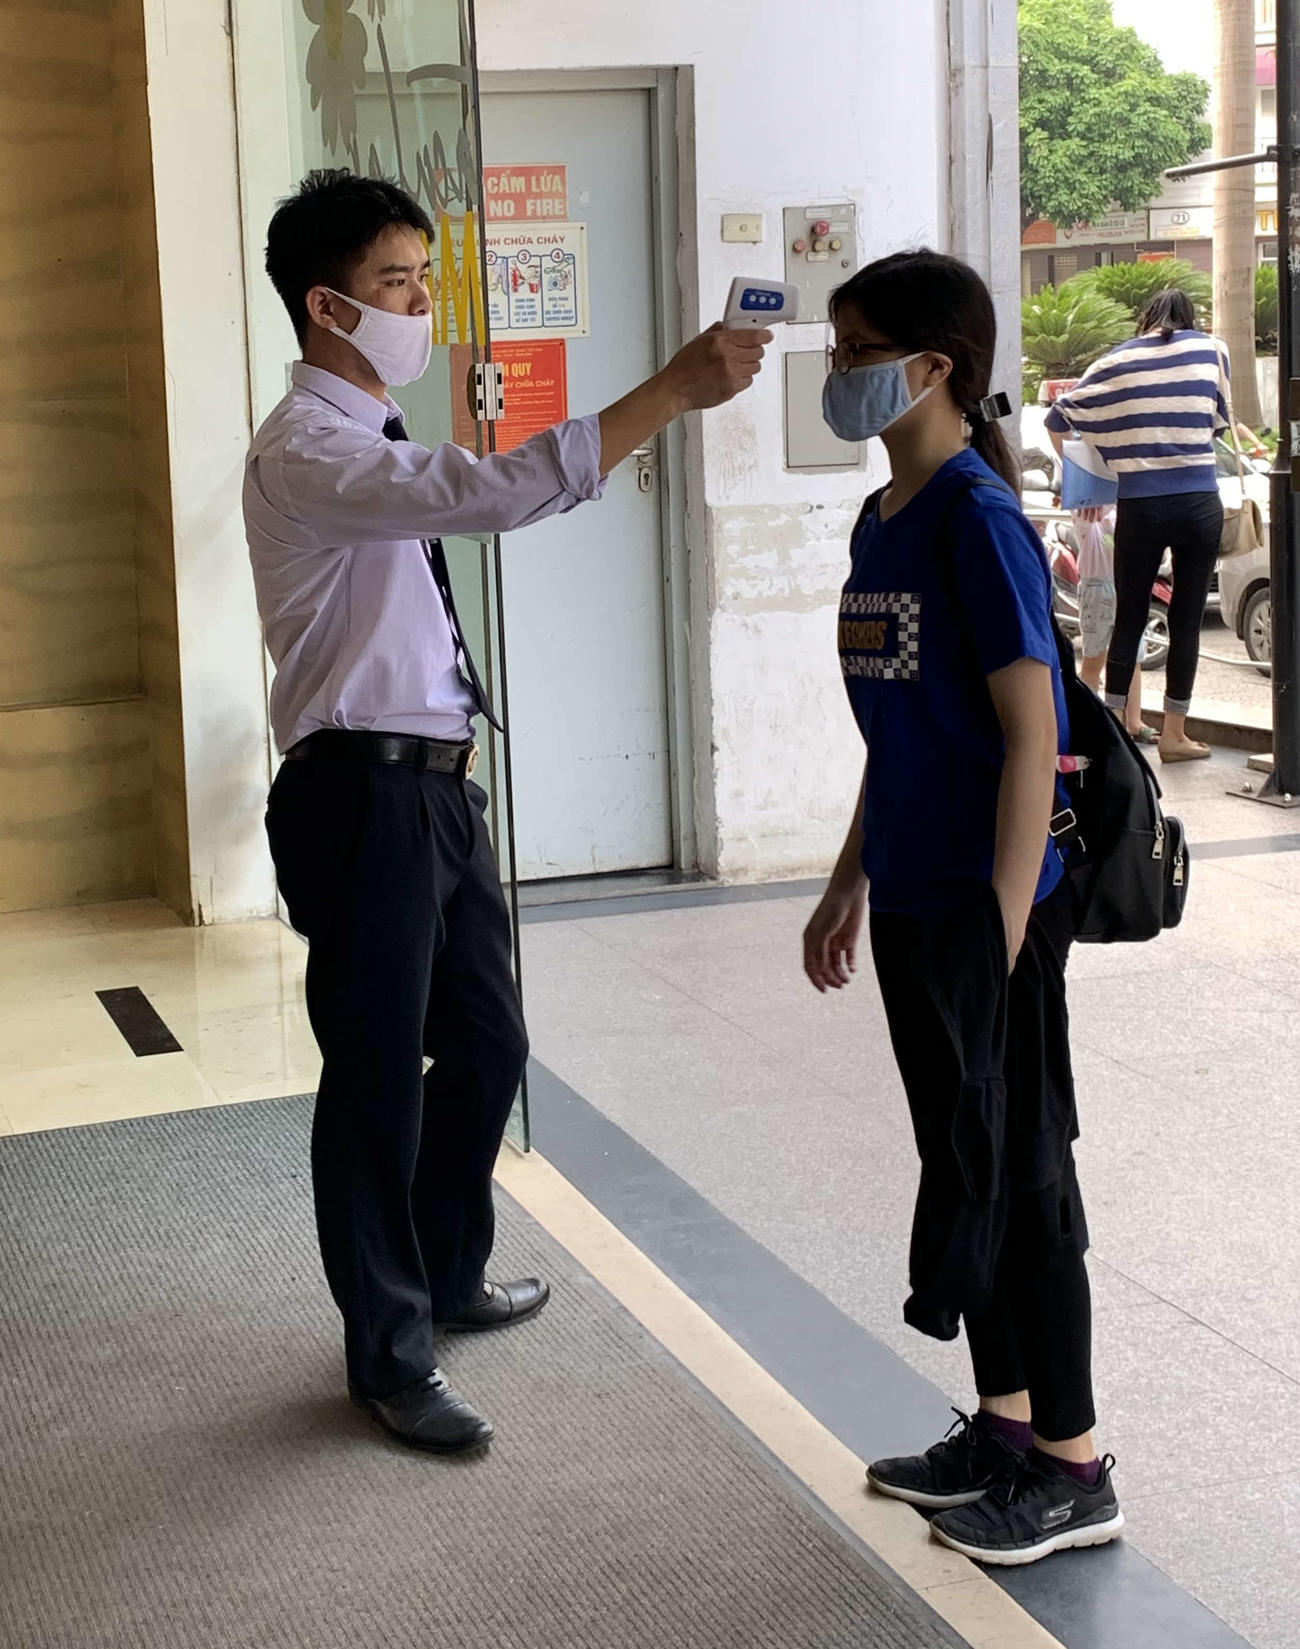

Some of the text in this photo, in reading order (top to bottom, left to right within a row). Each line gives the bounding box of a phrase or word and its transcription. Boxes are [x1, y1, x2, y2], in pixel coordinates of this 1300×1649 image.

[487, 169, 526, 194] CẤM
[489, 198, 565, 217] NO FIRE
[503, 235, 534, 246] CHỮA
[537, 234, 567, 245] CHÁY
[520, 252, 528, 262] 3
[553, 250, 562, 261] 4
[511, 361, 532, 377] QUY
